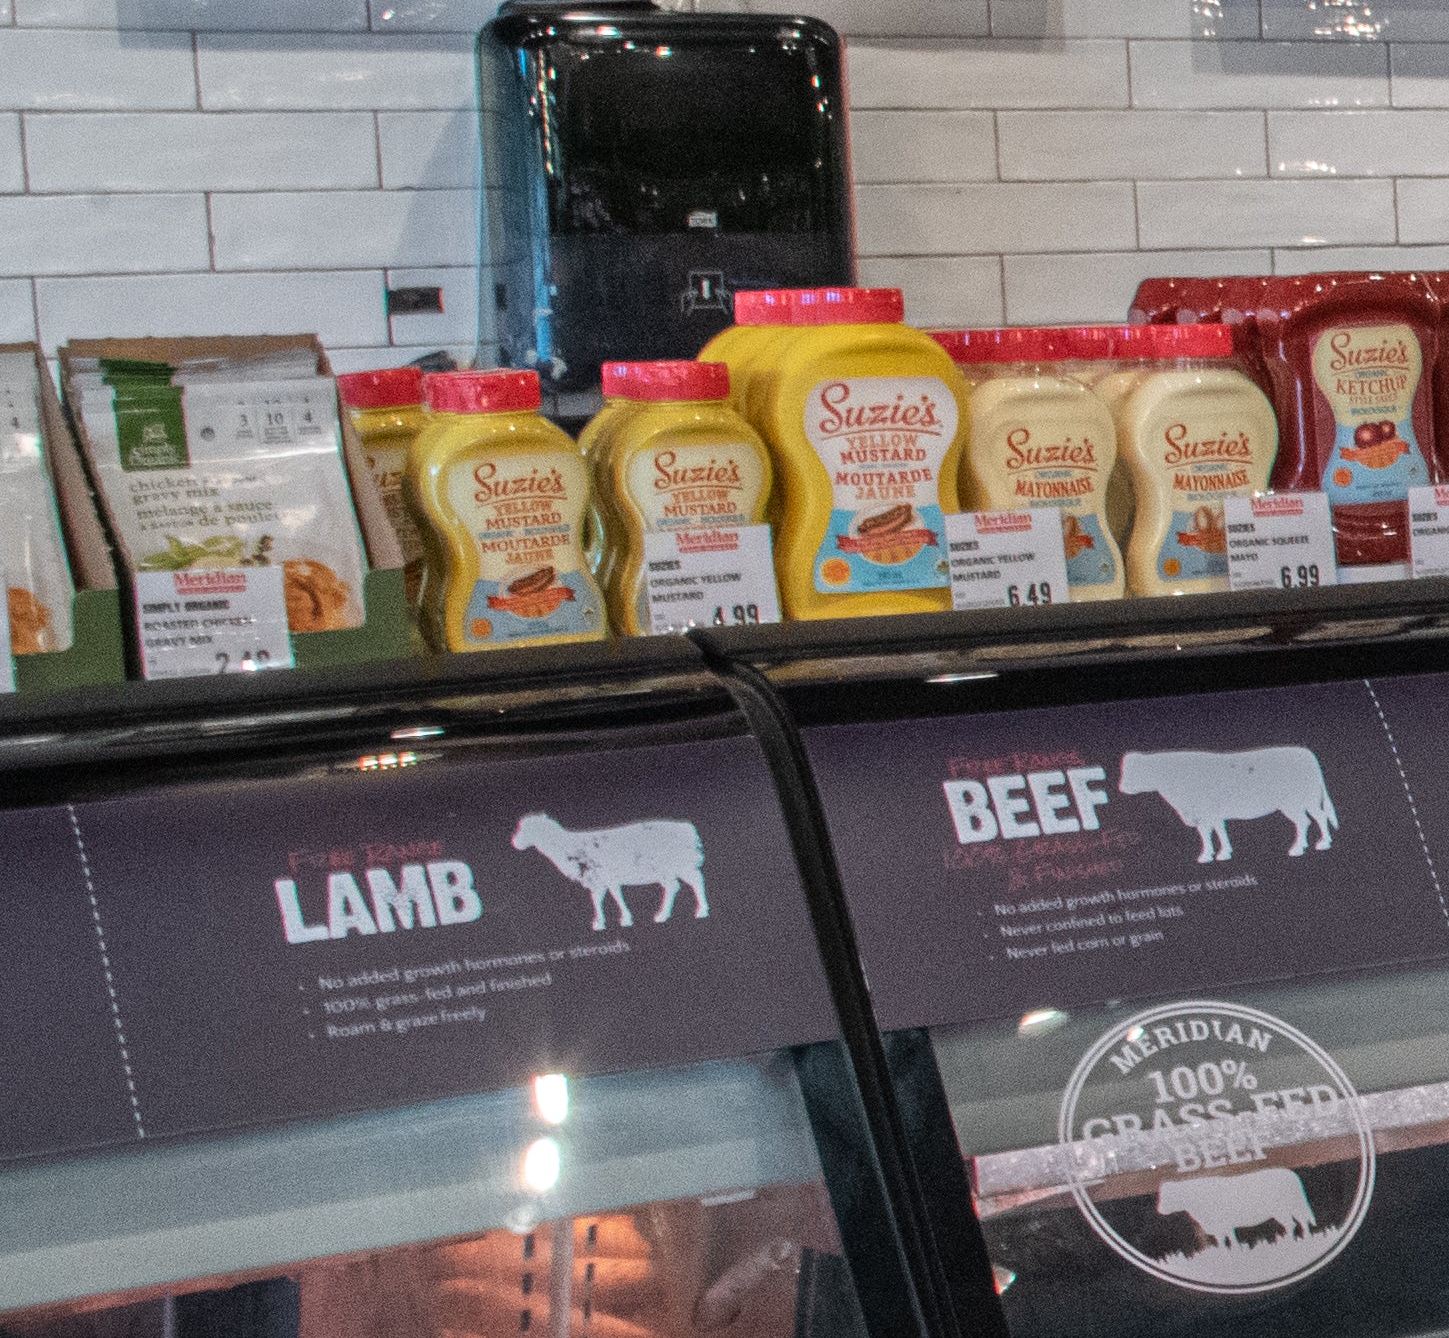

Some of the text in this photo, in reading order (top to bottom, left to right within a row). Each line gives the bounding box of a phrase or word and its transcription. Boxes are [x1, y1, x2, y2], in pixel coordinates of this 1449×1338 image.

[1330, 330, 1408, 371] Suzie's
[1336, 376, 1408, 397] KETCHUP
[819, 381, 943, 434] Suzie's
[840, 447, 927, 465] MUSTARD
[846, 434, 918, 451] YELLOW
[1006, 428, 1098, 470] Suzie's
[835, 467, 933, 486] MOUTARDE
[1015, 476, 1095, 499] MAYONNAISE
[1281, 564, 1320, 589] 6.99
[943, 766, 1109, 845] BEEF
[274, 860, 484, 944] LAMB
[1108, 1018, 1274, 1075] MERIDIAN
[1148, 1059, 1259, 1106] 100%
[1082, 1082, 1340, 1148] GRASS-FED
[1176, 1135, 1270, 1173] BEEF
